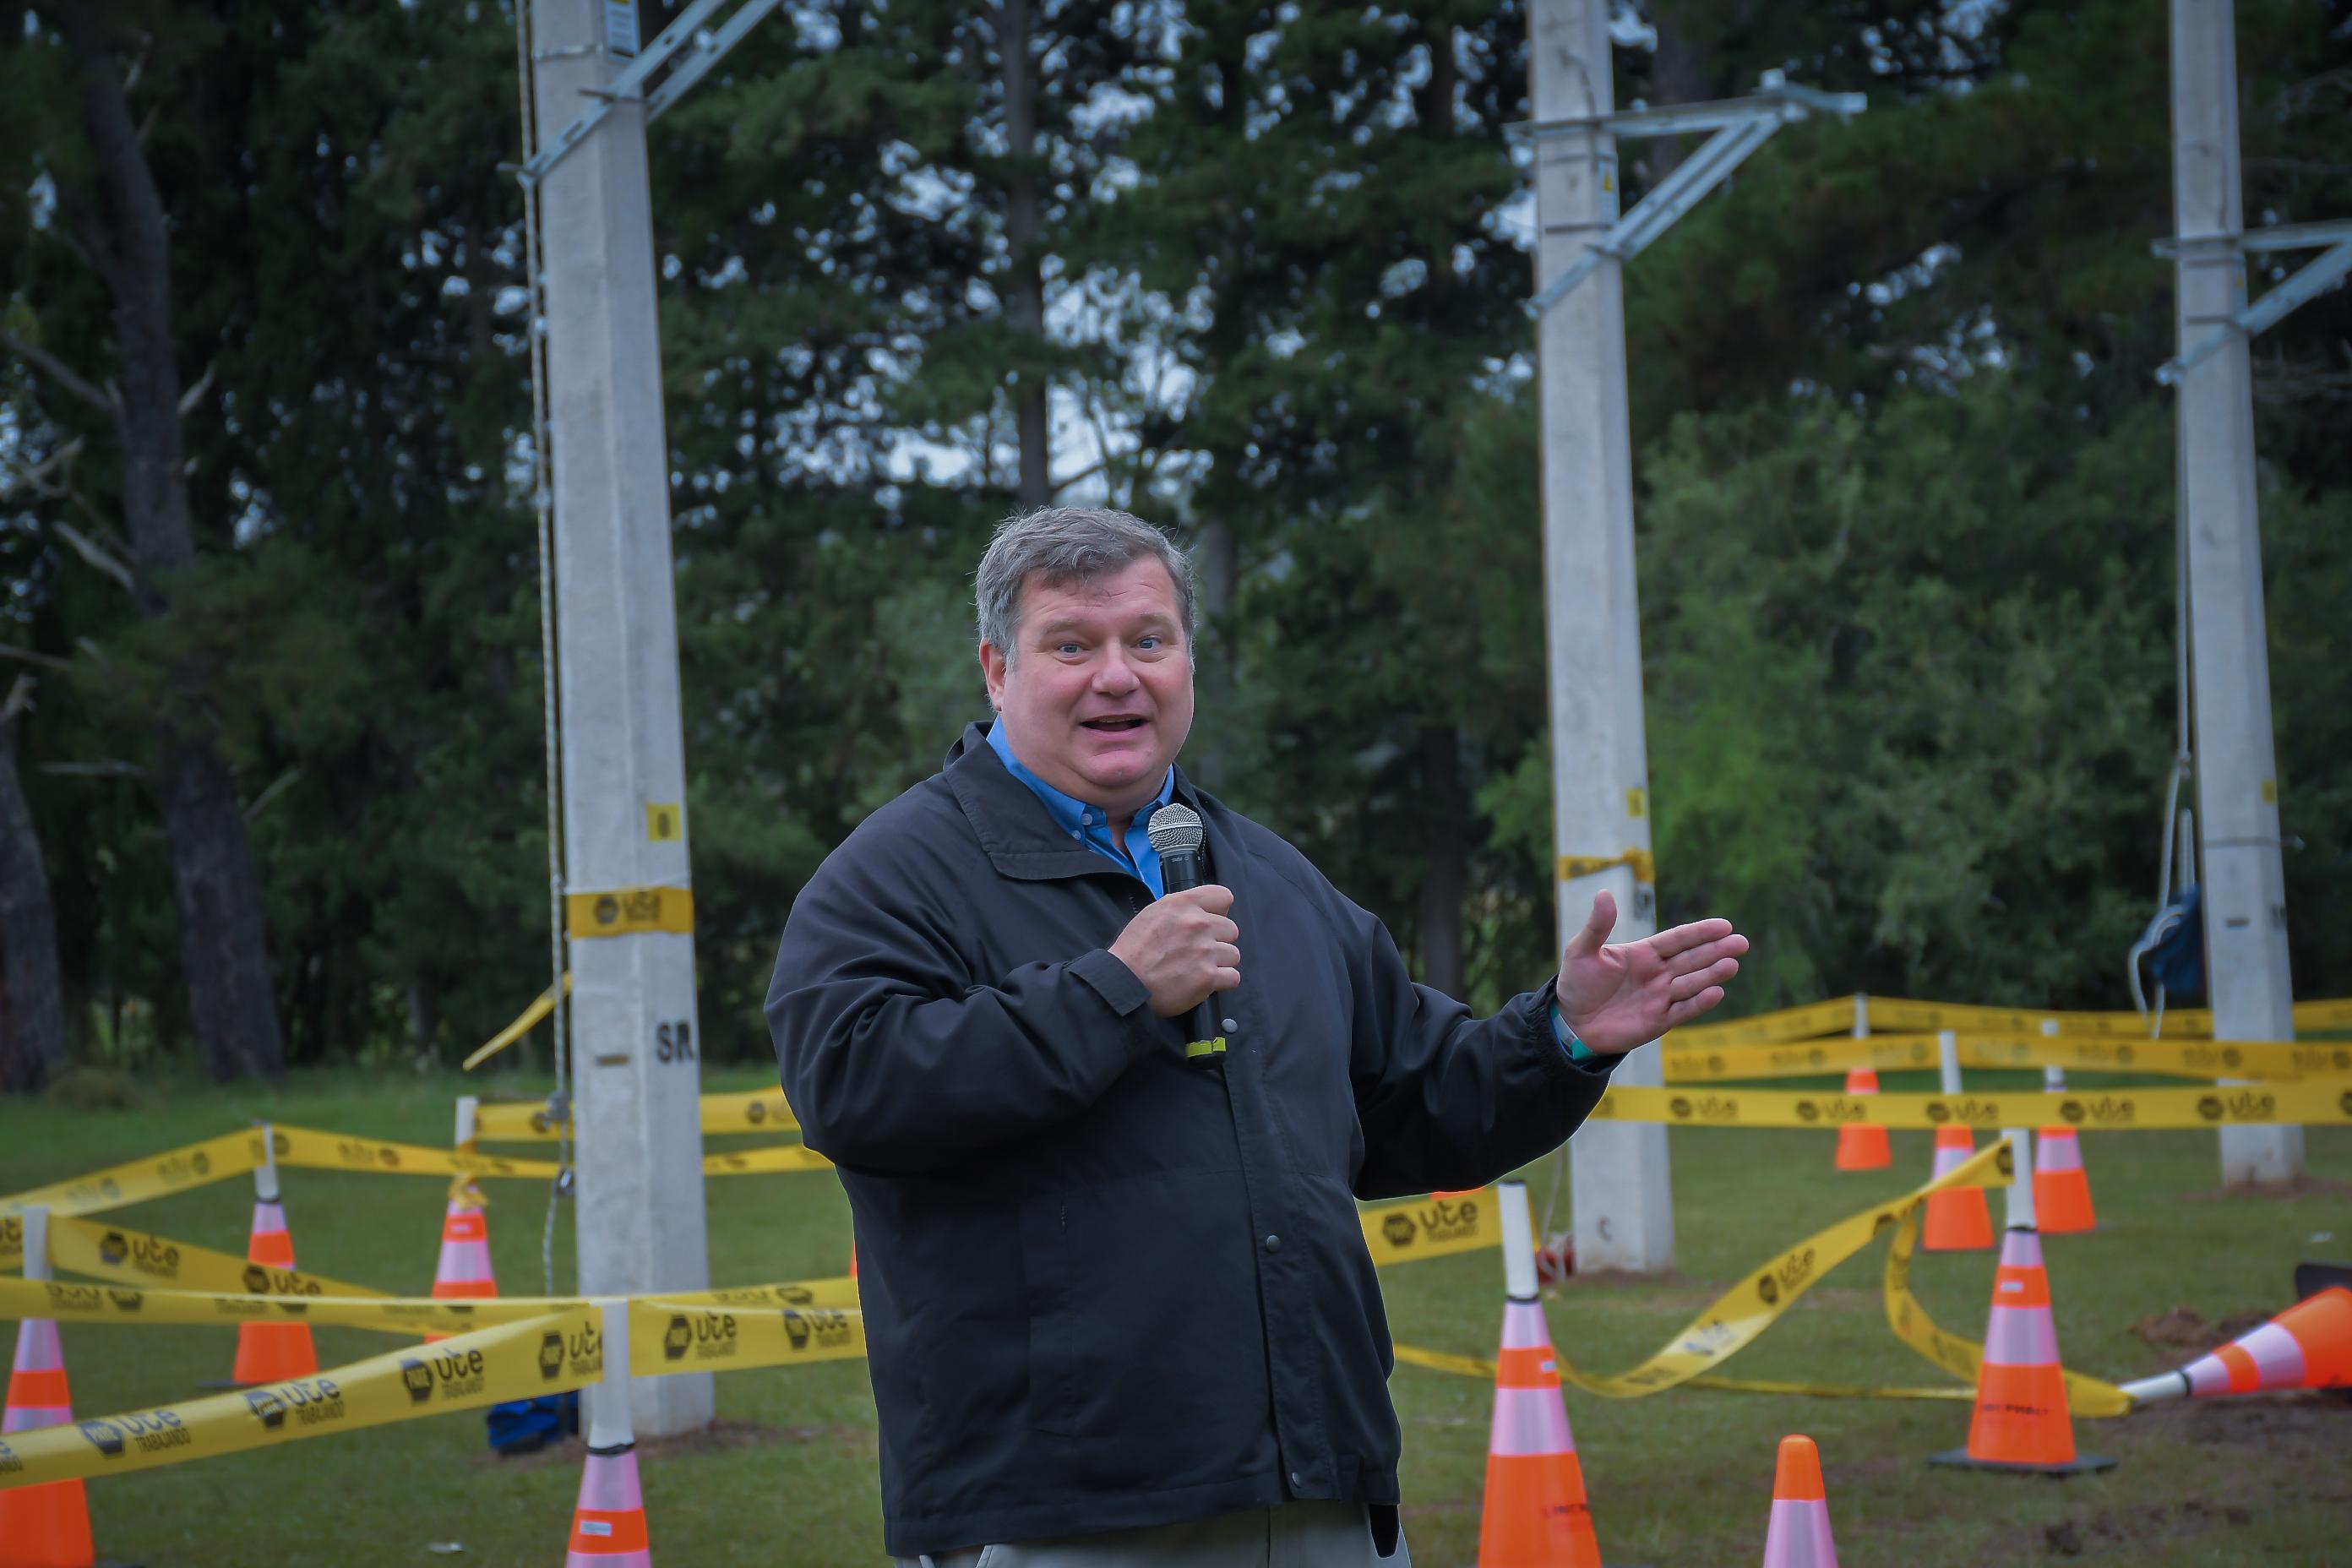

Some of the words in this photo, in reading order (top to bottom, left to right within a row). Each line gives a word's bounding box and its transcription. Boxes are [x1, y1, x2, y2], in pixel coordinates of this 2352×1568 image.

[1419, 1200, 1478, 1229] ute
[133, 1233, 179, 1266] ute
[696, 1310, 736, 1342] ute
[434, 1348, 483, 1381] ute
[280, 1378, 340, 1407] ute
[117, 1409, 181, 1435] ute
[134, 1428, 191, 1454] TRABAJANDO
